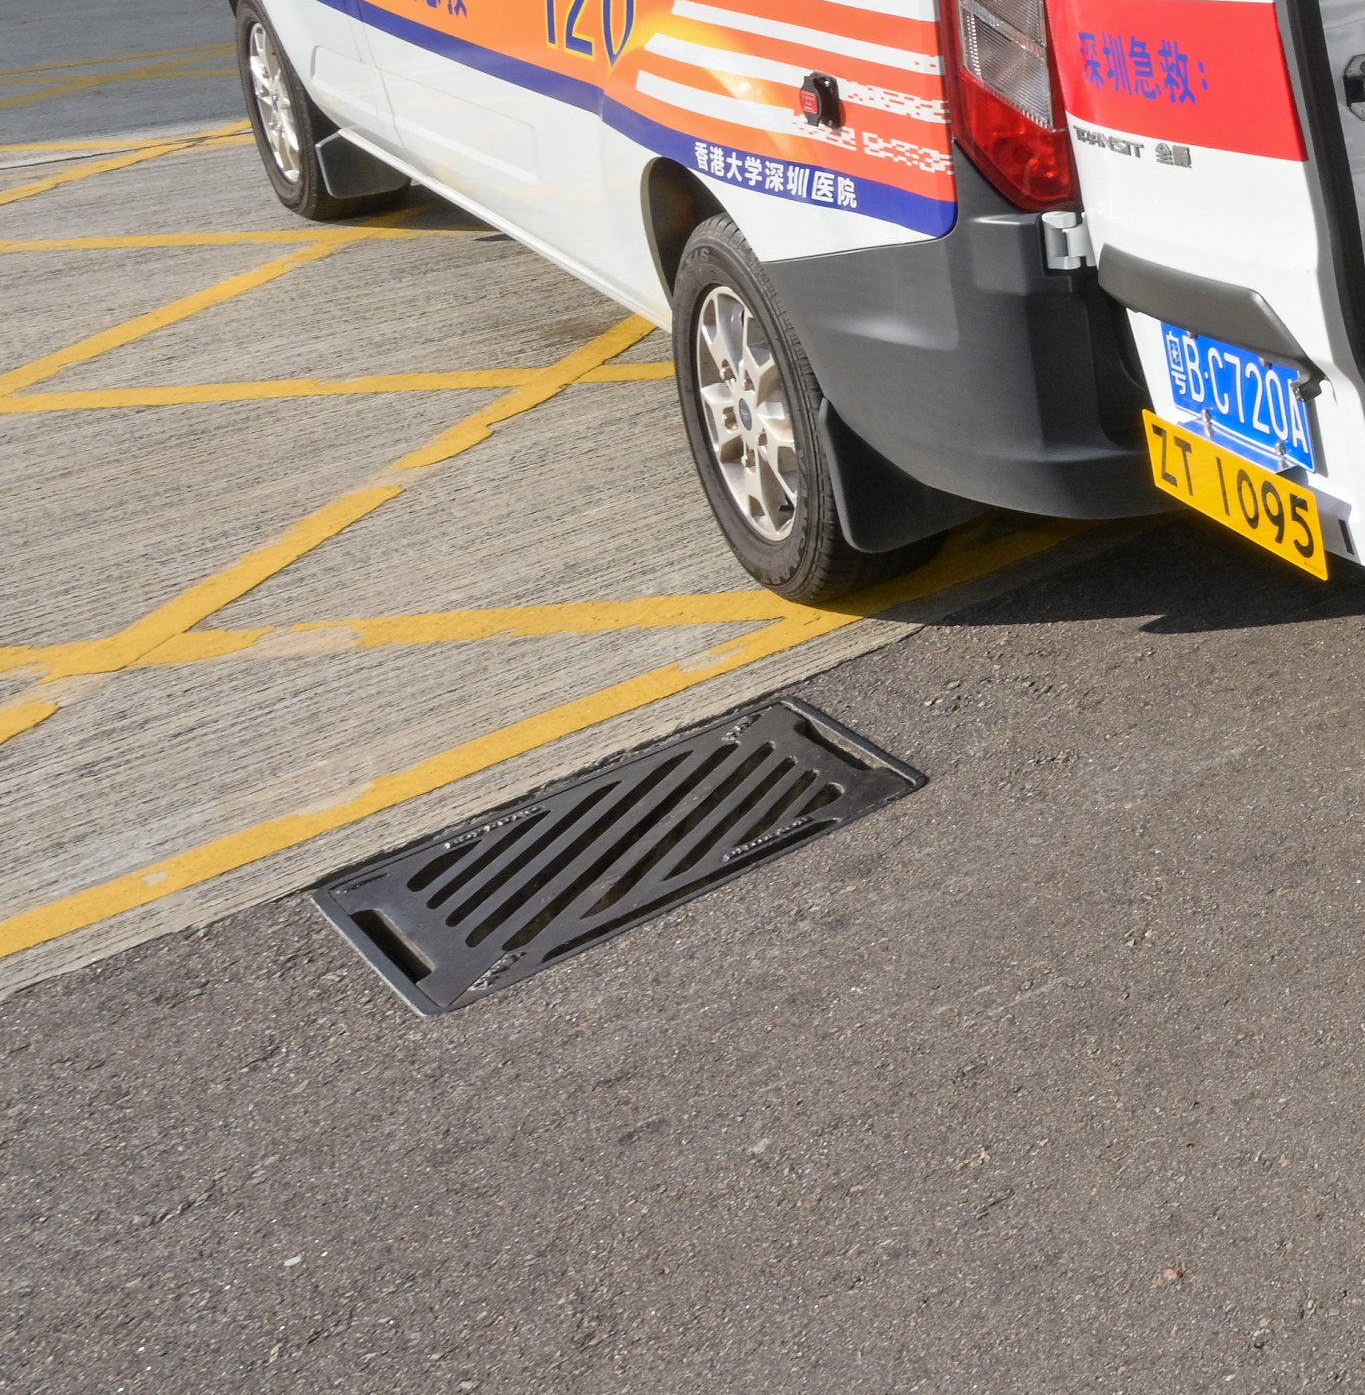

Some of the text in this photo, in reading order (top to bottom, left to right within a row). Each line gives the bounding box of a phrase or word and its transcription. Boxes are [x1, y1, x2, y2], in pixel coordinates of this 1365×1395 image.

[694, 141, 858, 209] 香港大学深圳医院
[1073, 125, 1145, 158] TRANSIT
[1152, 424, 1315, 559] ZT 1095
